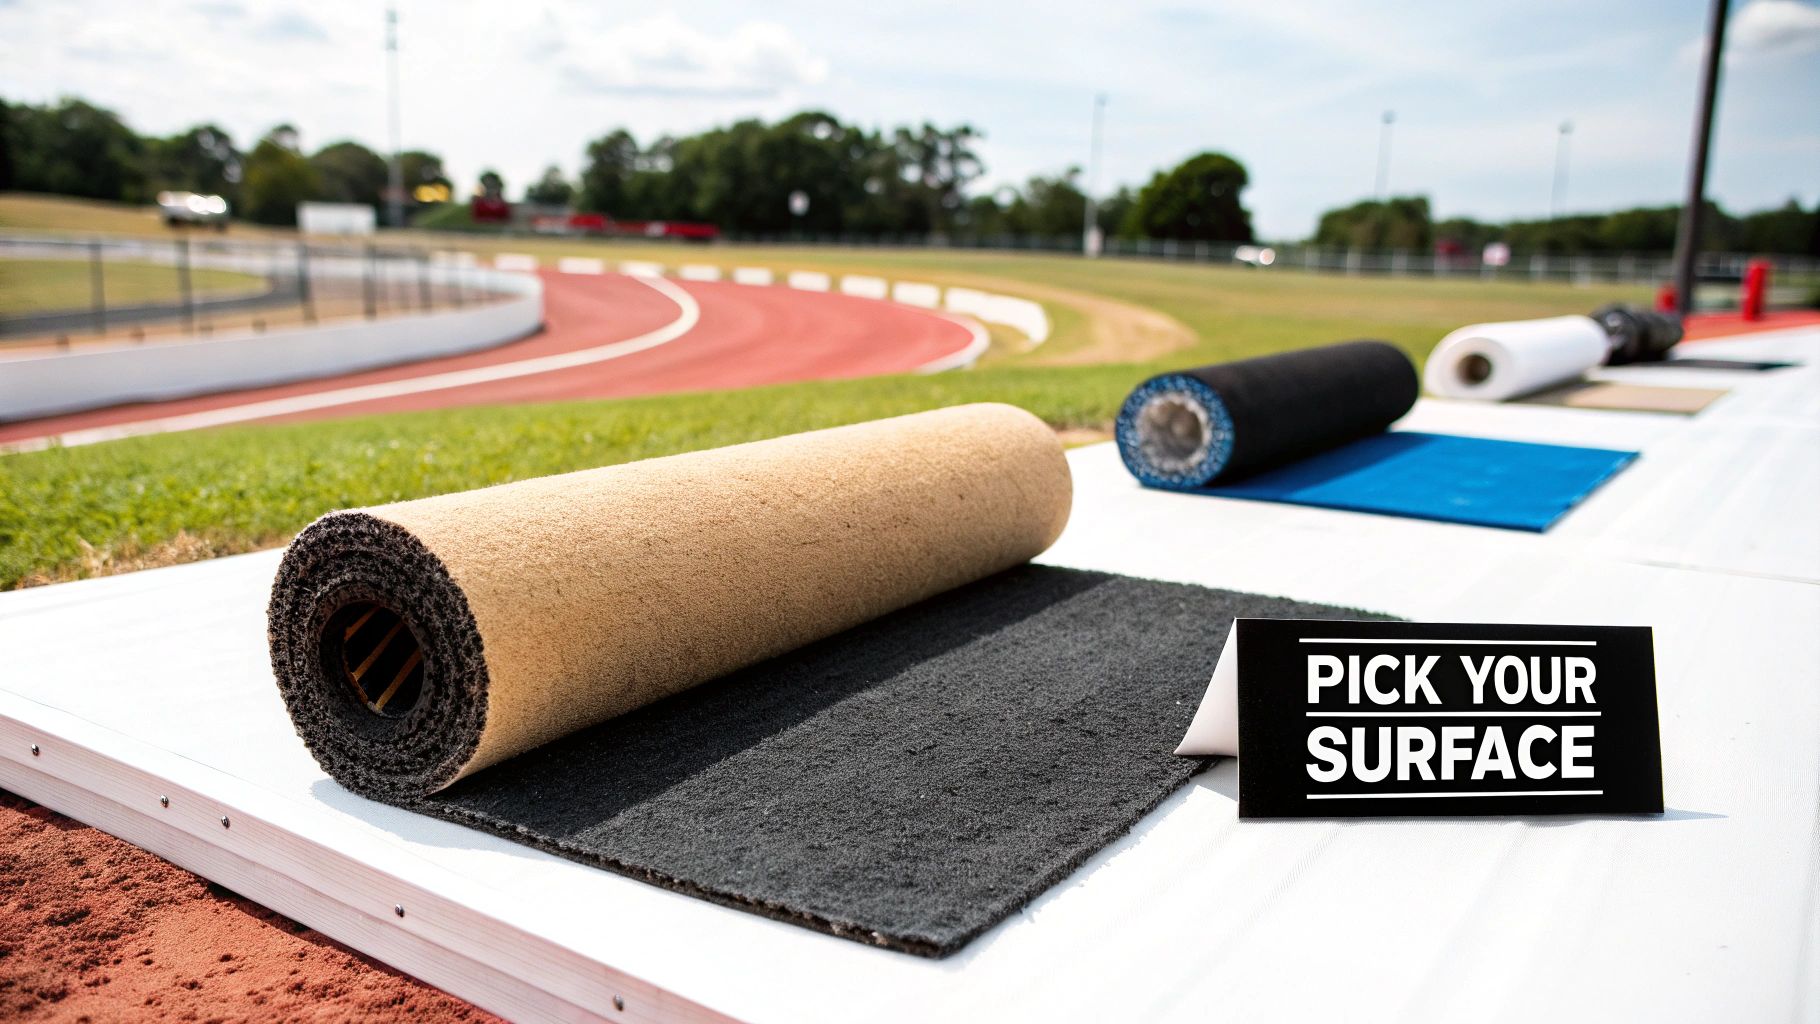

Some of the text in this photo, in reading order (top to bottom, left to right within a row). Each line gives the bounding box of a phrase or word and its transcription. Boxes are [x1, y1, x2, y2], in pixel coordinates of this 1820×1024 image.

[1307, 654, 1597, 705] PICK YOUR
[1305, 724, 1595, 783] SURFACE
